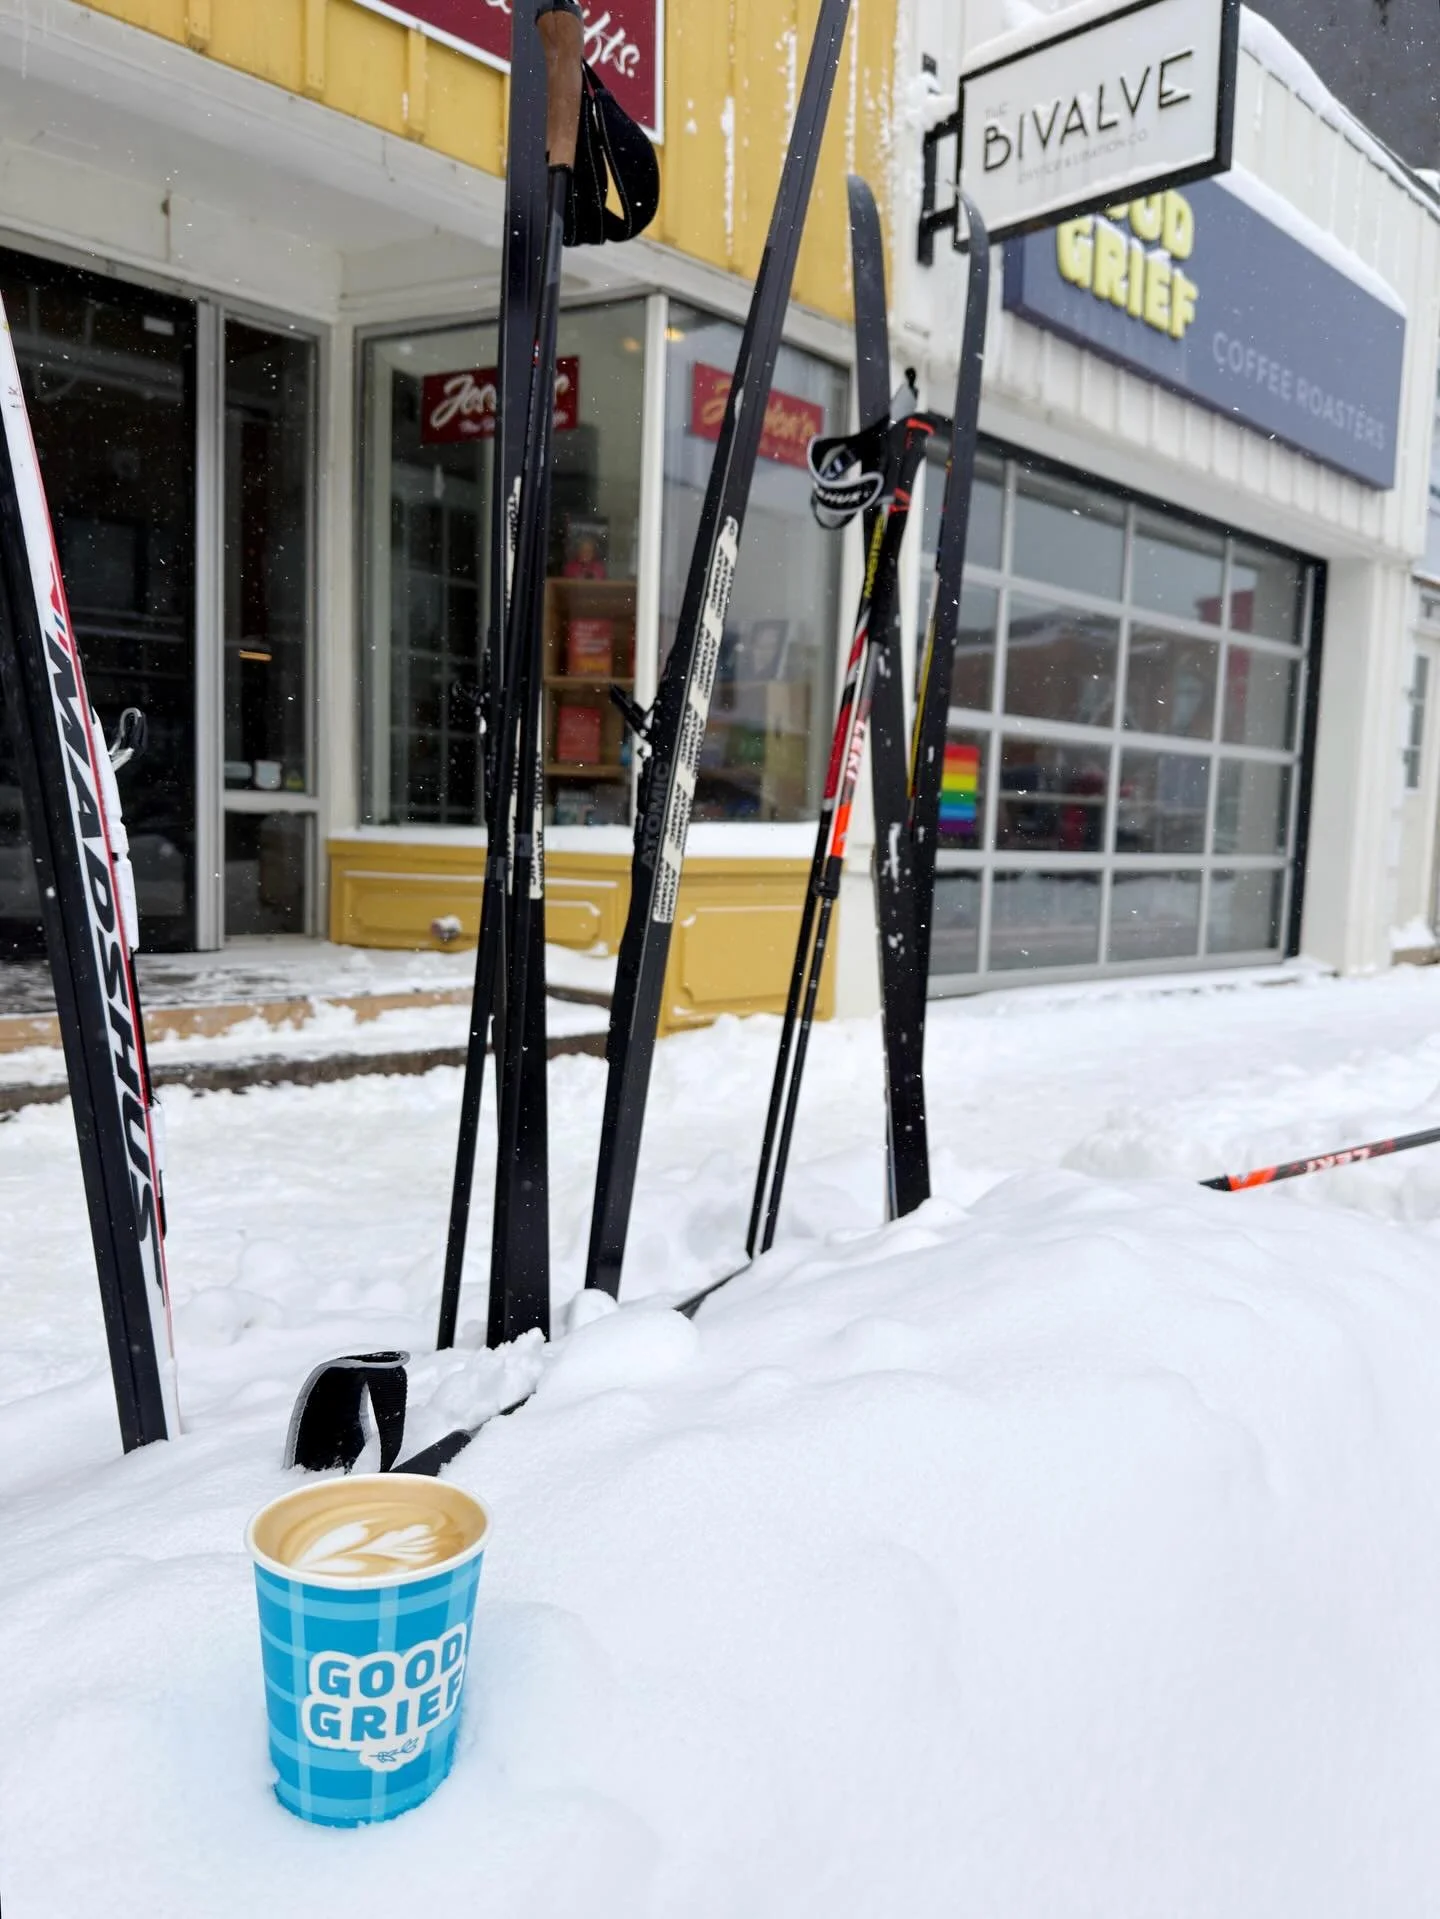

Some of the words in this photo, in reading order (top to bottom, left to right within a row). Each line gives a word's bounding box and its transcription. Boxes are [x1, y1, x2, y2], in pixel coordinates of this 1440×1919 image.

[983, 50, 1193, 171] BIVALVE
[1105, 189, 1196, 260] OD
[1056, 213, 1199, 340] GRIEF
[1212, 331, 1293, 402] COFFEE
[1296, 377, 1386, 451] ROASTERS
[709, 546, 724, 609] ATOMIC
[715, 556, 730, 618] ATOMIC
[696, 629, 711, 691] ATOMIC
[702, 638, 717, 699] ATOMIC
[685, 709, 700, 772] ATOMIC
[640, 762, 669, 870] ATOMIC
[668, 782, 682, 842] ATOMIC
[674, 790, 688, 850] ATOMIC
[46, 630, 151, 1245] MADSHUS
[318, 1632, 464, 1699] GOOD
[309, 1672, 463, 1743] GRIEF
